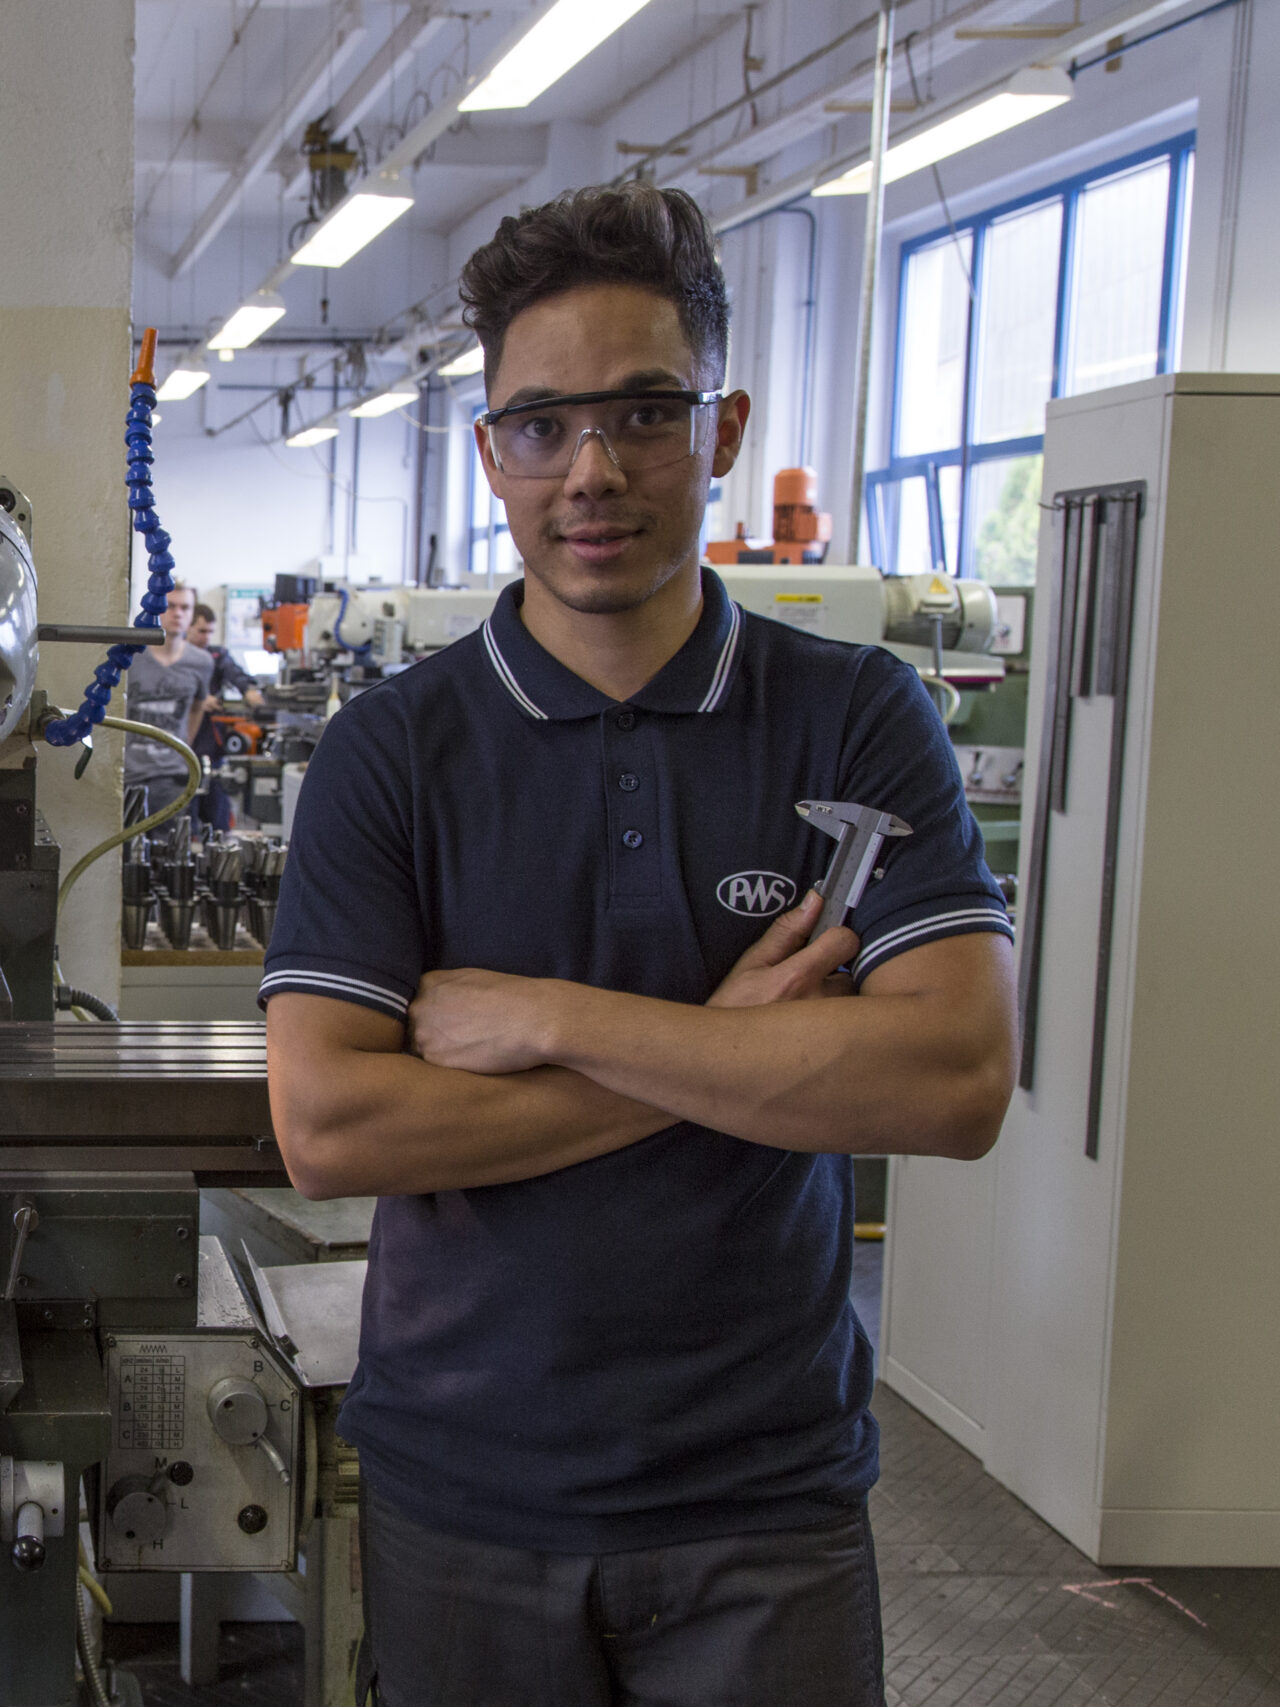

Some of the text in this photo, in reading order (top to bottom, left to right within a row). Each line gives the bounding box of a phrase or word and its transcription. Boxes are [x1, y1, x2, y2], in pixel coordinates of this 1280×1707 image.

[253, 1360, 264, 1372] B
[124, 1375, 132, 1383] A
[123, 1402, 131, 1411] B
[279, 1399, 291, 1411] C
[122, 1430, 130, 1439] C
[154, 1457, 168, 1469] M
[180, 1498, 190, 1510] L
[152, 1539, 164, 1550] H
